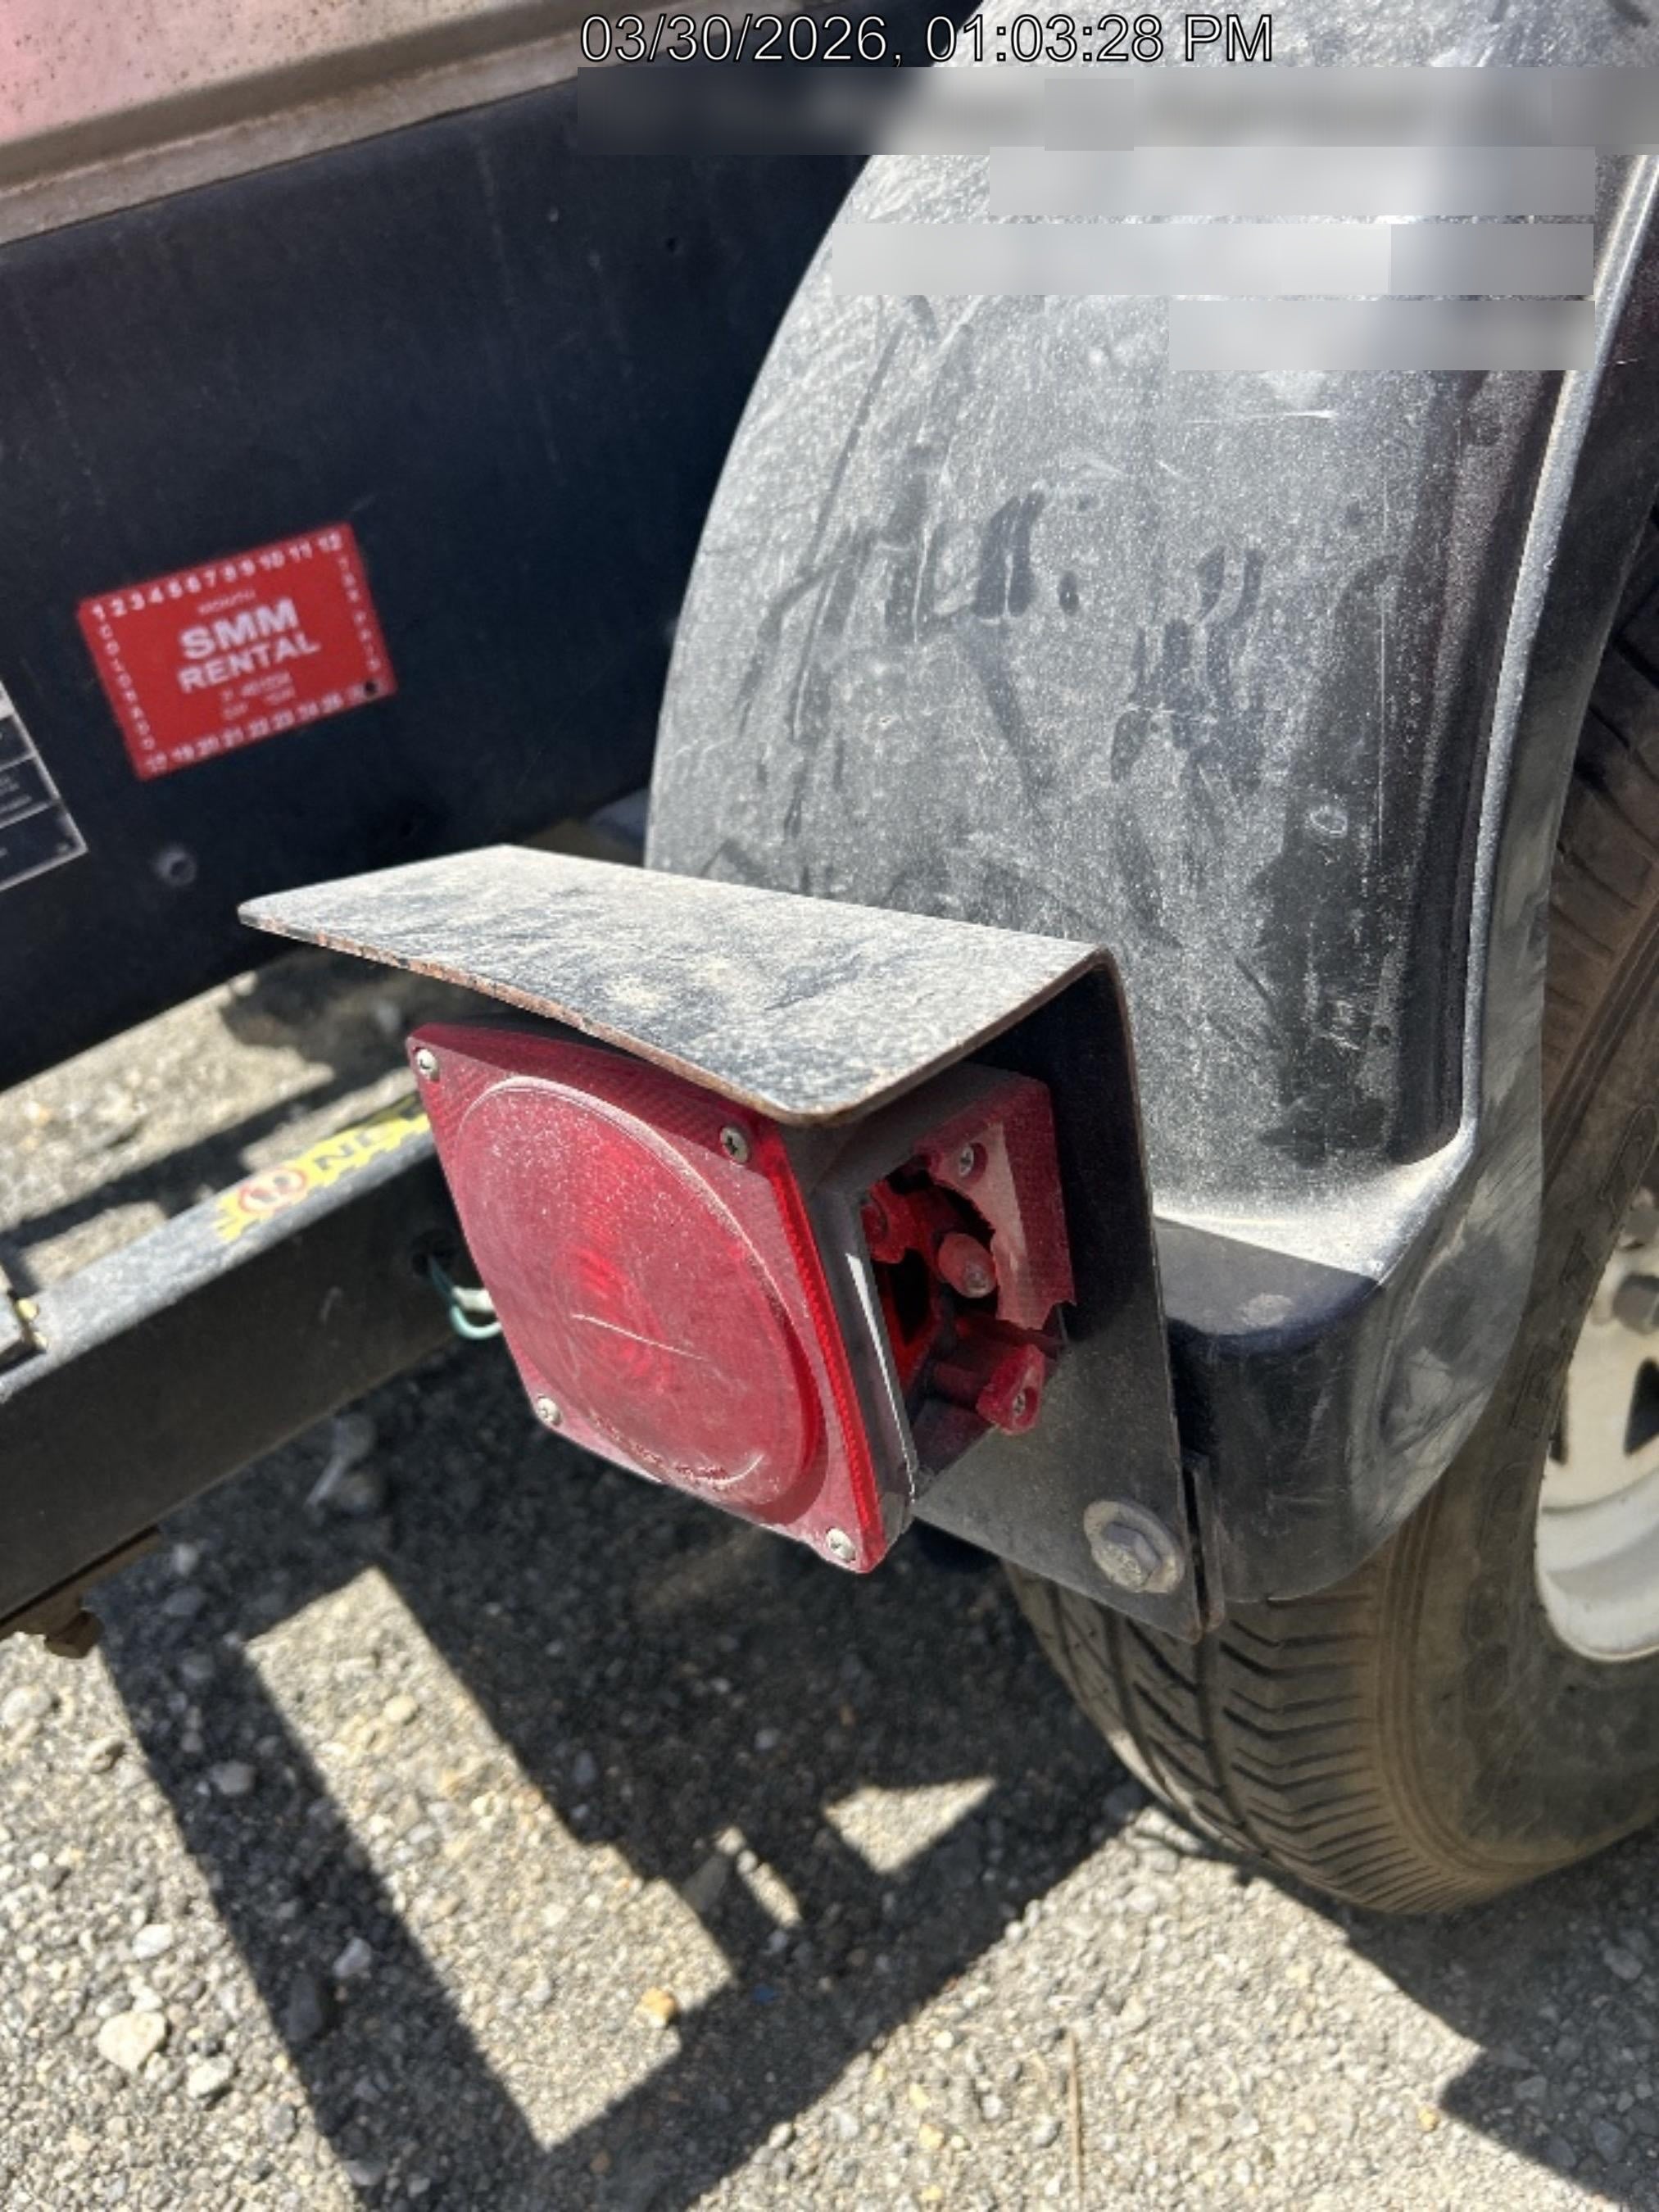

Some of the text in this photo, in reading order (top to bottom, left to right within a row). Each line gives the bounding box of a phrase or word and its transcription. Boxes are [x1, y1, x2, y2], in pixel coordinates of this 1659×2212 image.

[92, 603, 106, 621] 1
[110, 597, 127, 617] 2
[129, 591, 146, 610] 3
[148, 587, 165, 604] 4
[202, 568, 217, 587] 7
[258, 549, 285, 570] 10
[288, 540, 313, 561] 11
[180, 599, 298, 660] SMM
[178, 632, 320, 692] RENTAL
